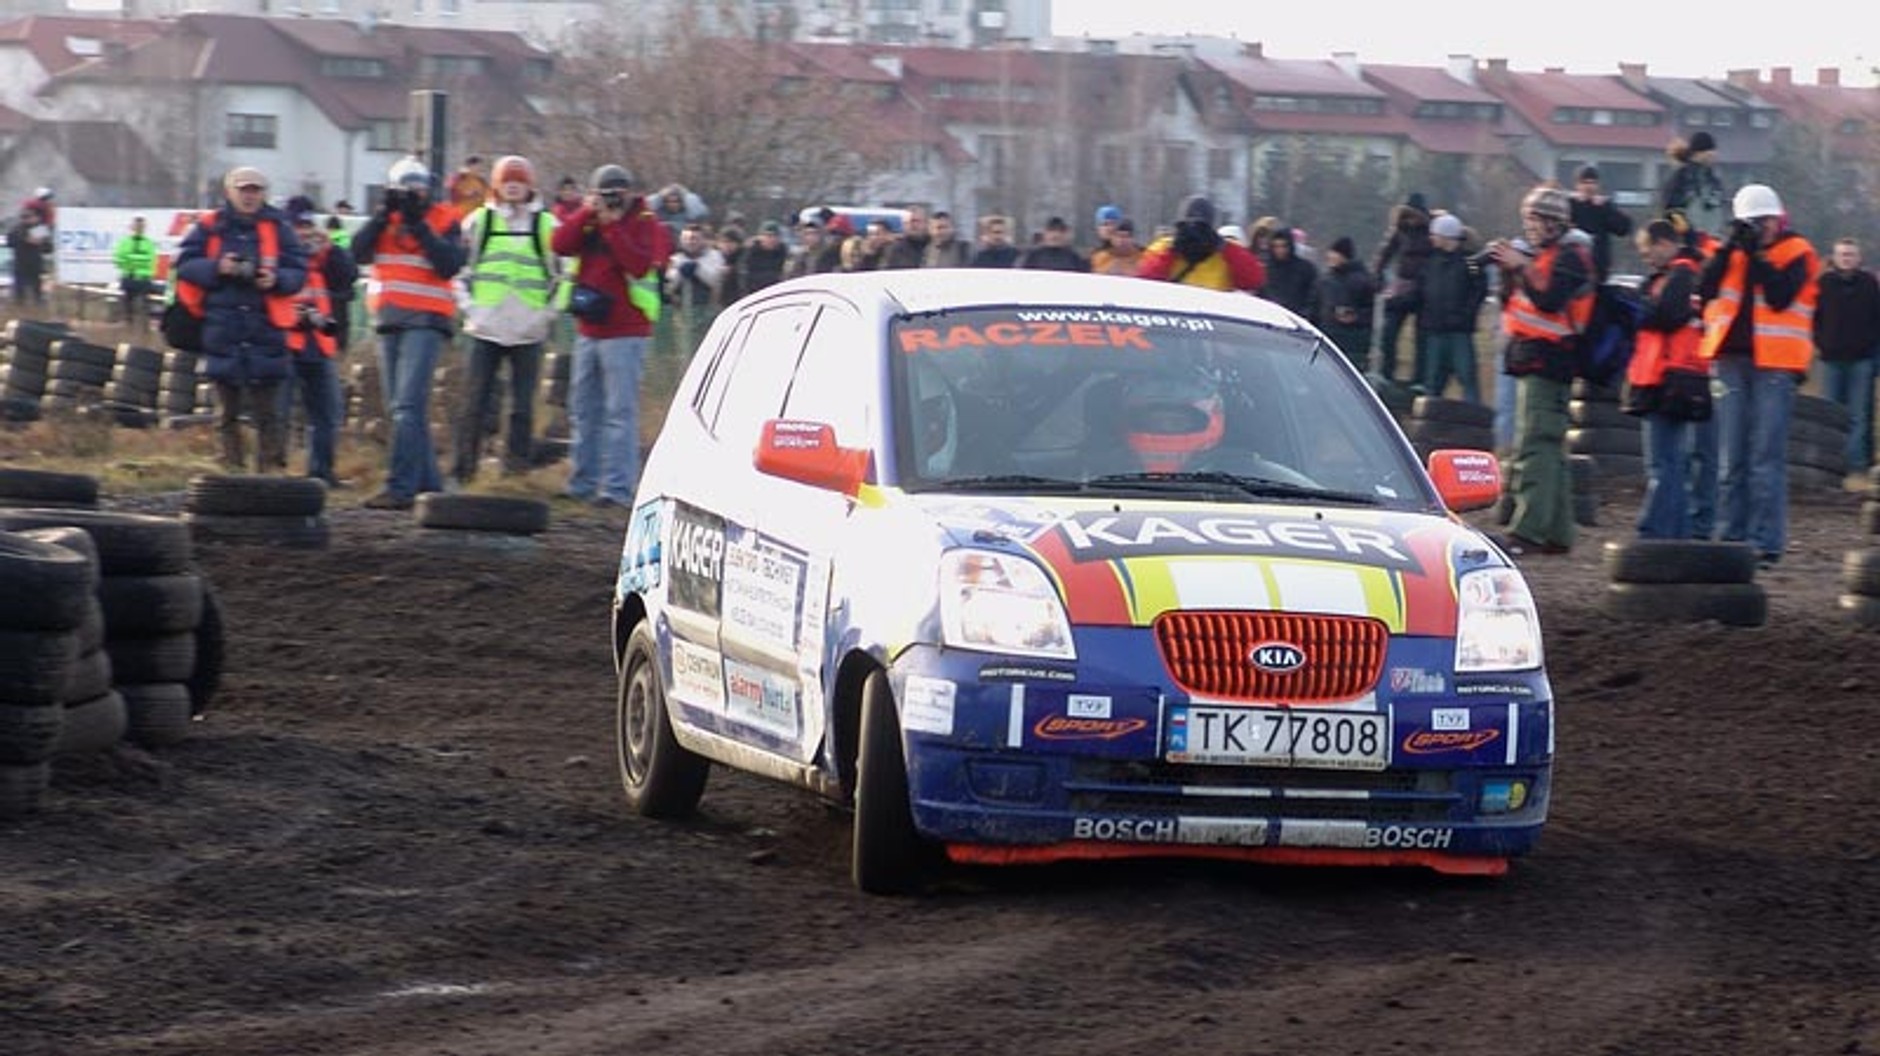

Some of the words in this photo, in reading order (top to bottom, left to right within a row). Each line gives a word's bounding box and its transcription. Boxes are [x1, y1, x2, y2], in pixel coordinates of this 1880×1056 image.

[1017, 310, 1215, 331] www.kager.pl
[899, 321, 1157, 352] RACZEK
[669, 518, 724, 582] KAGER
[1064, 516, 1410, 561] KAGER
[1259, 649, 1297, 665] KIA
[1045, 718, 1130, 732] SPORT
[1196, 712, 1247, 752] TK
[1264, 714, 1379, 757] 77808
[1413, 732, 1487, 746] SPORT
[1073, 818, 1177, 842] BOSCH
[1364, 826, 1453, 849] BOSCH
